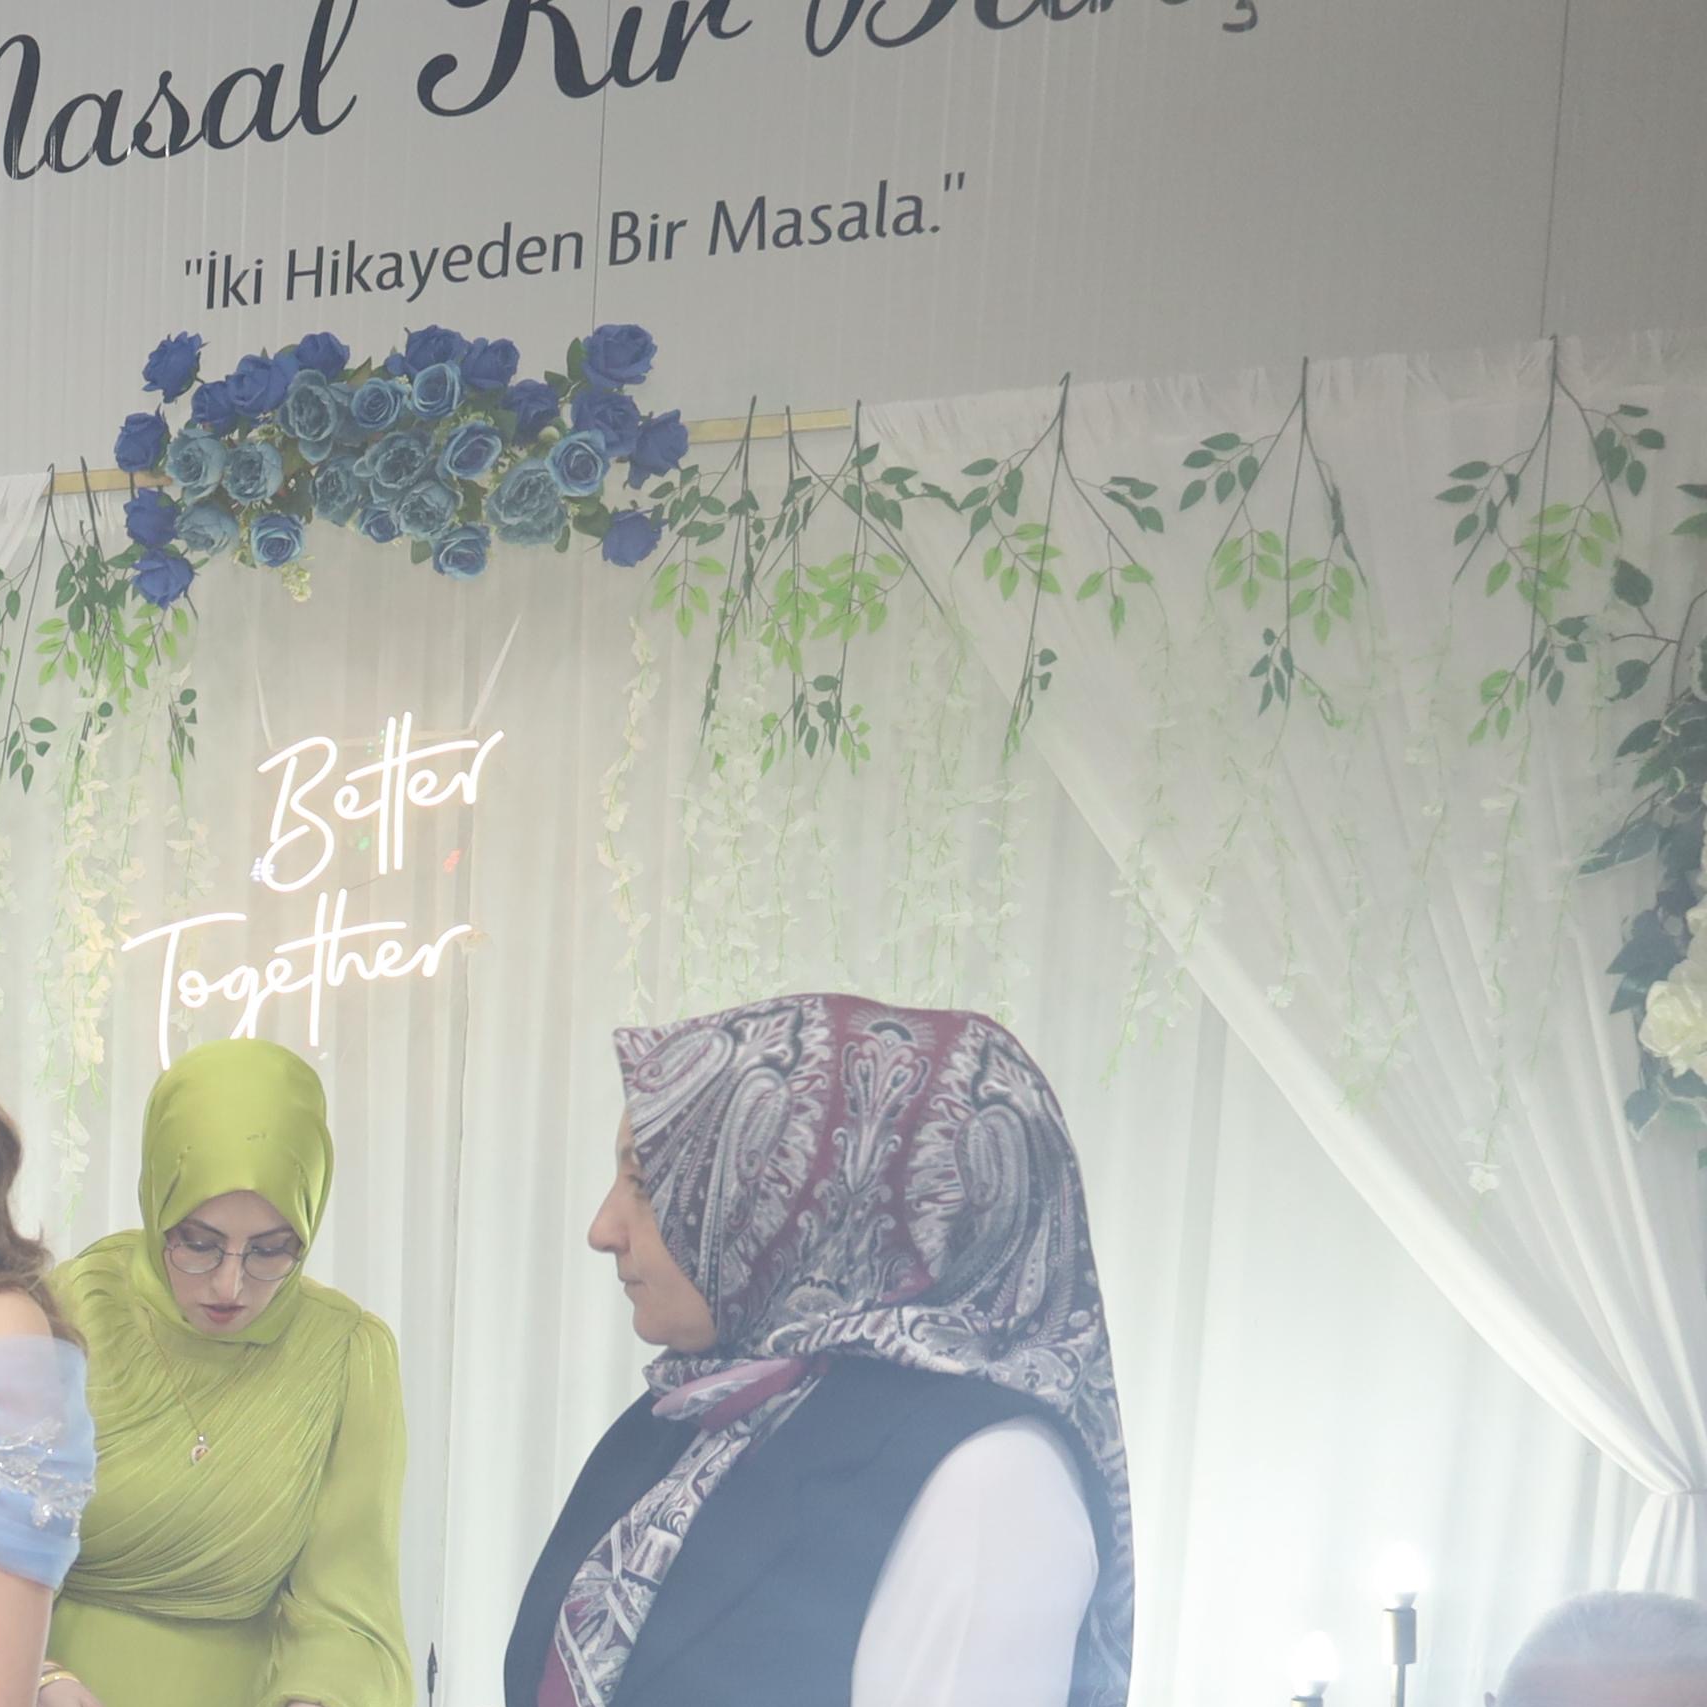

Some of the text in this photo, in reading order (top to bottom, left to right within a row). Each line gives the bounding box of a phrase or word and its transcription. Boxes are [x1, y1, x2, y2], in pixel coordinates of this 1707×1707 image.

[284, 220, 585, 304] Hikayeden
[607, 208, 688, 267] Bir
[706, 172, 967, 257] Masala."
[257, 711, 505, 893] Better
[120, 888, 472, 1070] Together
